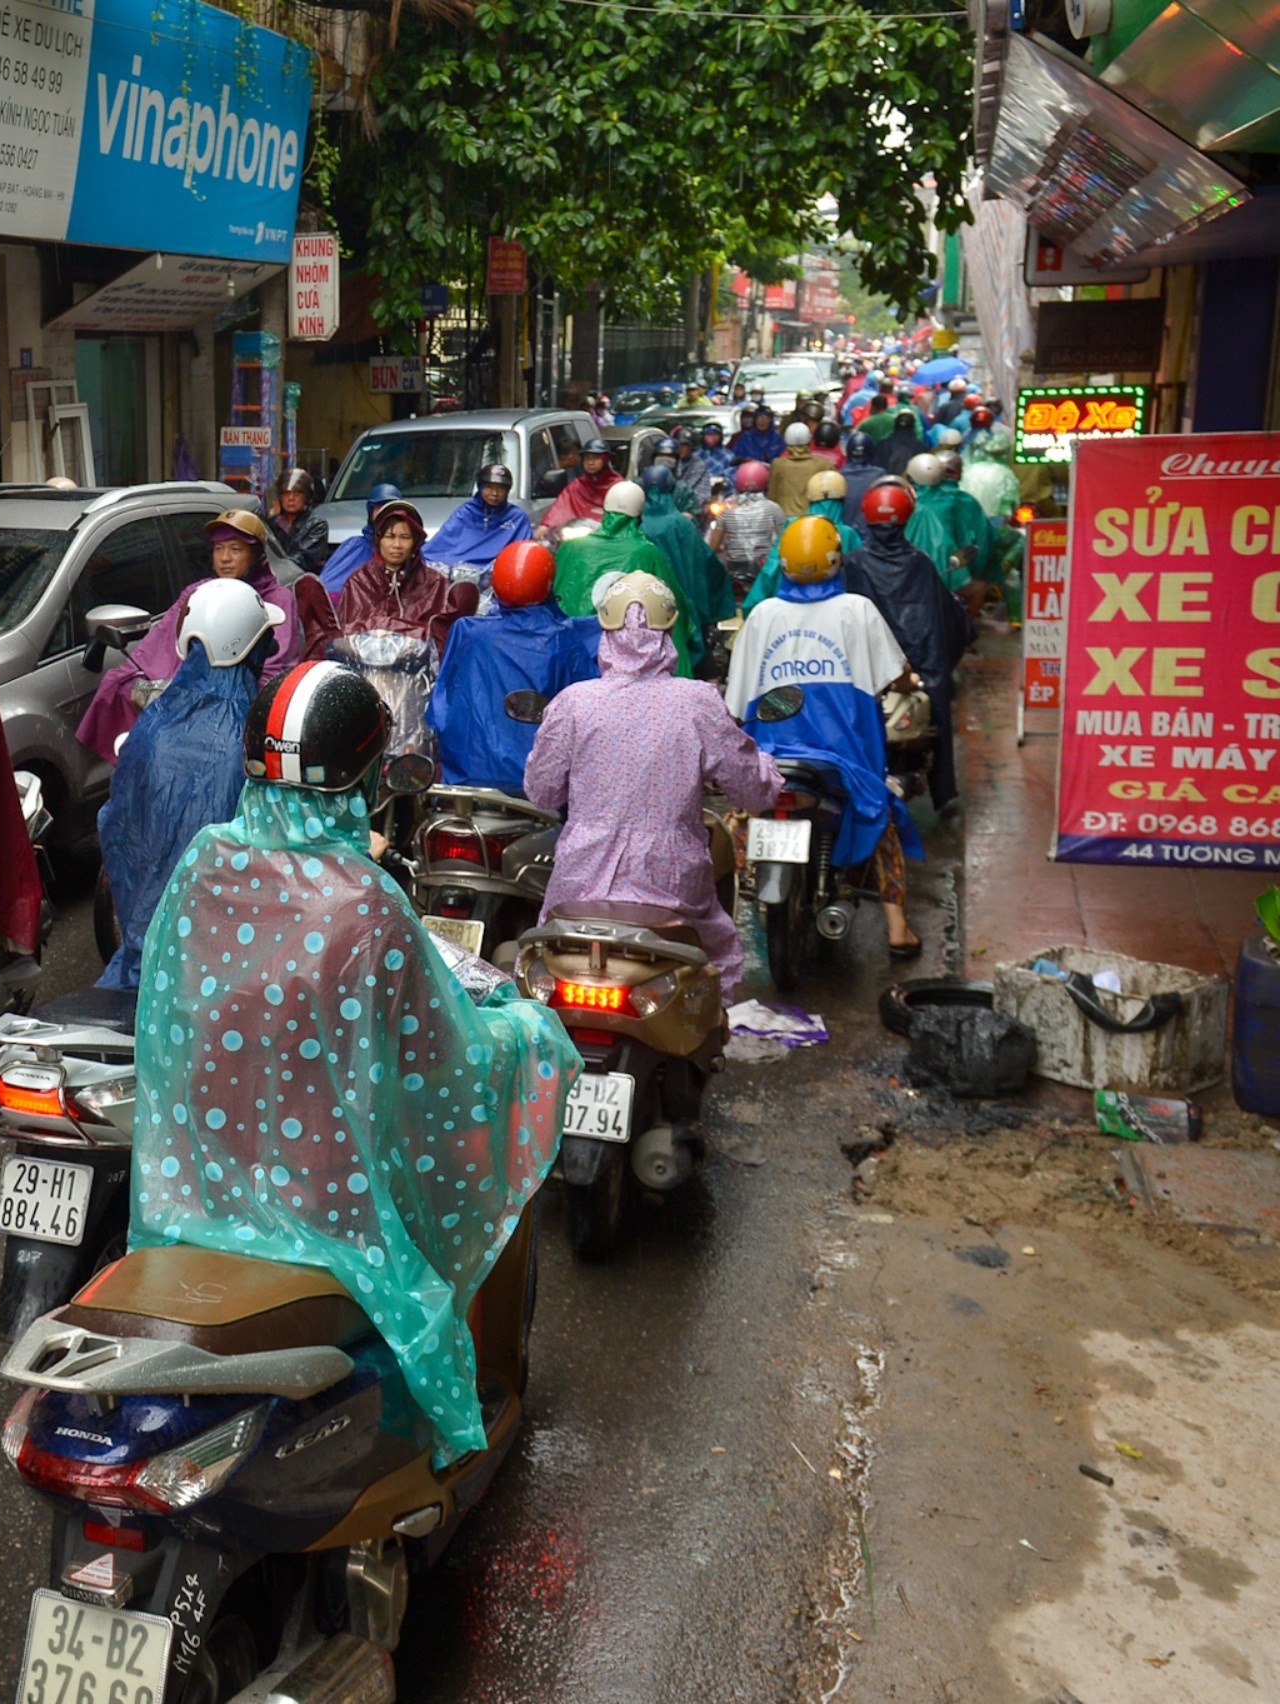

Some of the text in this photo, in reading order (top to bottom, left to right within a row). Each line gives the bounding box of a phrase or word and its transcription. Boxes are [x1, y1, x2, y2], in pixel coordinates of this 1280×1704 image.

[12, 15, 31, 43] XE
[34, 22, 54, 50] DU
[55, 29, 84, 59] LỊCH
[13, 60, 29, 86] 58
[31, 65, 46, 91] 49
[48, 70, 63, 95] 99
[23, 107, 51, 136] NGỌC
[0, 143, 15, 167] 556
[295, 238, 334, 257] KHUNG
[296, 261, 329, 283] NHÔM
[1091, 486, 1280, 557] SỬA C
[1087, 572, 1213, 622] XE
[1081, 647, 1206, 697] XE
[1076, 710, 1142, 736] MUA
[1151, 706, 1214, 738] BÁN
[264, 736, 301, 753] Owen
[1098, 743, 1277, 771] XE MÁY
[1108, 777, 1208, 802] GIÁ
[1081, 811, 1127, 832] ĐT:
[1138, 813, 1218, 836] 0968
[1122, 843, 1154, 860] 44
[13, 1163, 76, 1200] 29-H1
[2, 1197, 79, 1237] 884.46
[54, 1426, 114, 1447] HONDA
[274, 1415, 351, 1459] LEAD
[47, 1604, 149, 1677] 34-B2
